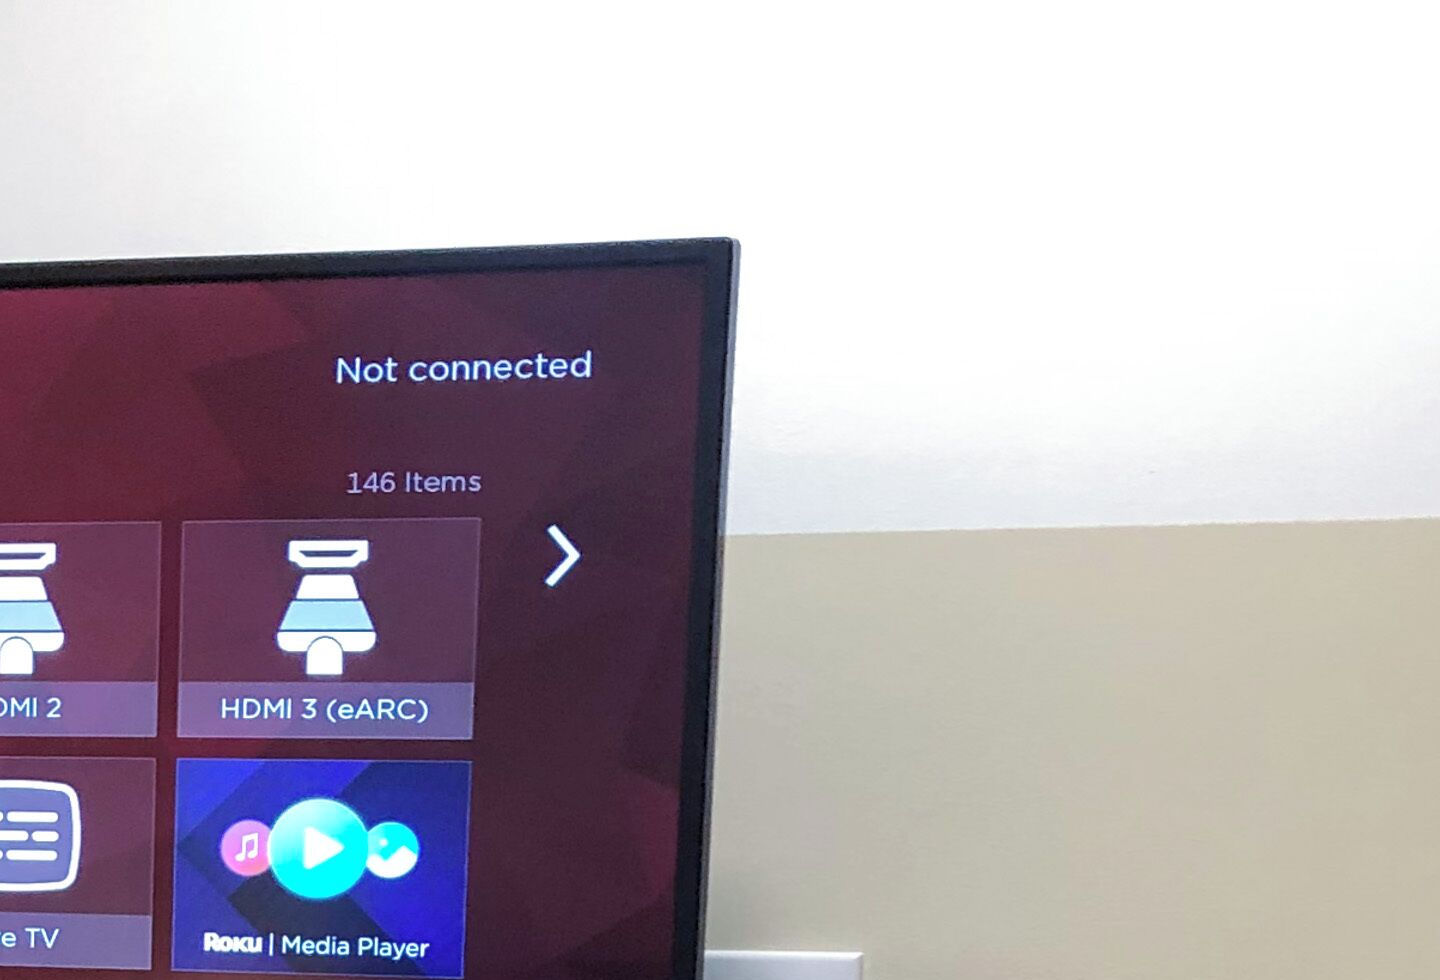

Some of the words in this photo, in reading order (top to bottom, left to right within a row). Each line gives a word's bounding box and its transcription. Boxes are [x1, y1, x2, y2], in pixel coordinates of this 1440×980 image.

[336, 357, 399, 383] Not
[407, 350, 593, 382] connected
[346, 471, 396, 494] 146
[404, 470, 482, 493] Items
[46, 697, 62, 718] 2
[221, 698, 292, 720] HDMI
[301, 698, 317, 720] 3
[326, 697, 429, 723] (eARC)
[25, 928, 60, 949] TV
[281, 934, 350, 957] Media
[357, 937, 430, 960] Player
